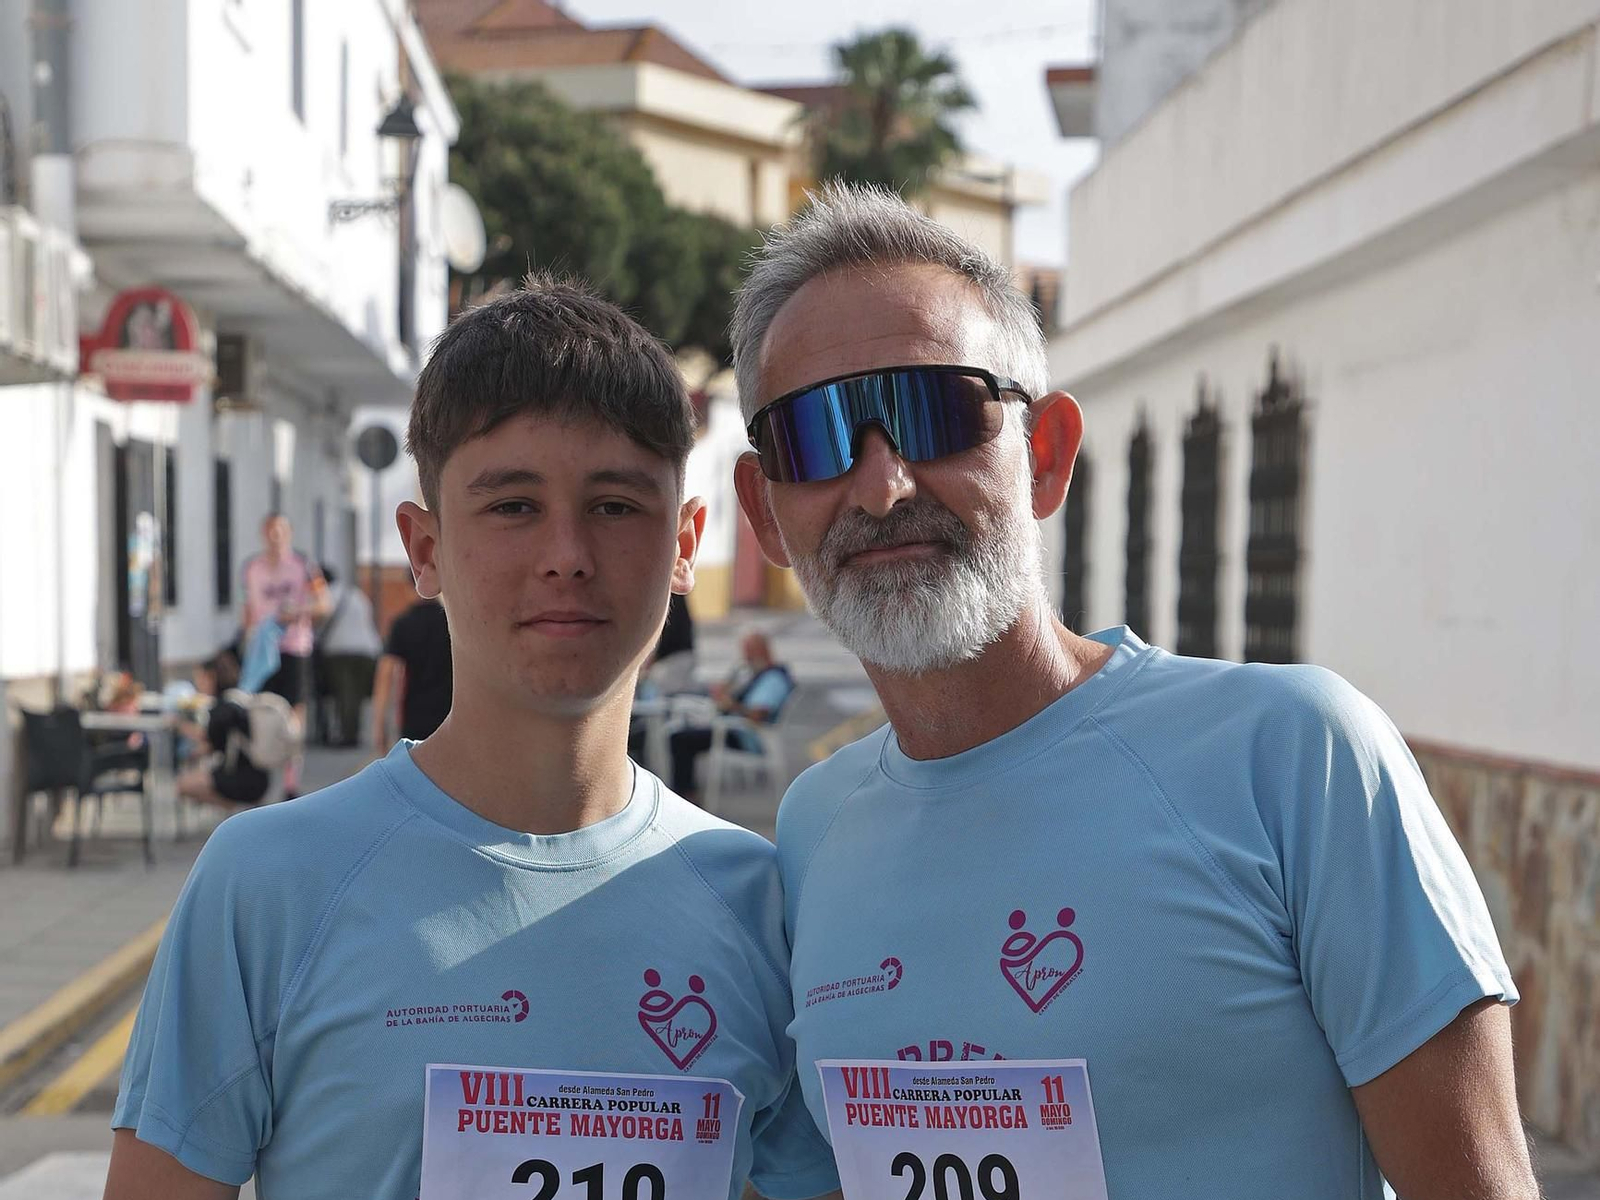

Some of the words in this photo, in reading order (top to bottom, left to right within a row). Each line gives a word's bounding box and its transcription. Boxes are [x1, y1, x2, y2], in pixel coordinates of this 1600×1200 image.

[842, 974, 885, 989] PORTUARIA
[847, 985, 885, 997] ALGECIRAS
[386, 1005, 449, 1018] AUTORIDAD
[453, 1004, 510, 1013] PORTUARIA
[402, 1018, 413, 1026] LA
[416, 1015, 445, 1025] BAHÍA
[448, 1015, 459, 1023] DE
[462, 1015, 511, 1023] ALGECIRAS
[841, 1067, 892, 1099] VIII
[912, 1076, 930, 1086] desde
[931, 1076, 959, 1086] Alameda
[960, 1076, 974, 1085] San
[975, 1075, 995, 1085] Pedro
[460, 1071, 525, 1106] VIII
[558, 1085, 581, 1094] desde
[583, 1086, 615, 1096] Alameda
[616, 1087, 631, 1096] San
[632, 1088, 655, 1097] Pedro
[893, 1088, 951, 1101] CARRERA
[954, 1089, 1022, 1101] POPULAR
[1041, 1075, 1065, 1103] 11
[526, 1096, 604, 1110] CARRERA
[608, 1100, 682, 1114] POPULAR
[702, 1092, 721, 1119] 11
[1040, 1104, 1071, 1118] MAYO
[845, 1103, 919, 1129] PUENTE
[924, 1105, 1029, 1129] MAYORGA
[1041, 1117, 1072, 1126] DOMINGO
[458, 1109, 561, 1136] PUENTE
[570, 1113, 684, 1141] MAYORGA
[696, 1119, 721, 1132] MAYO
